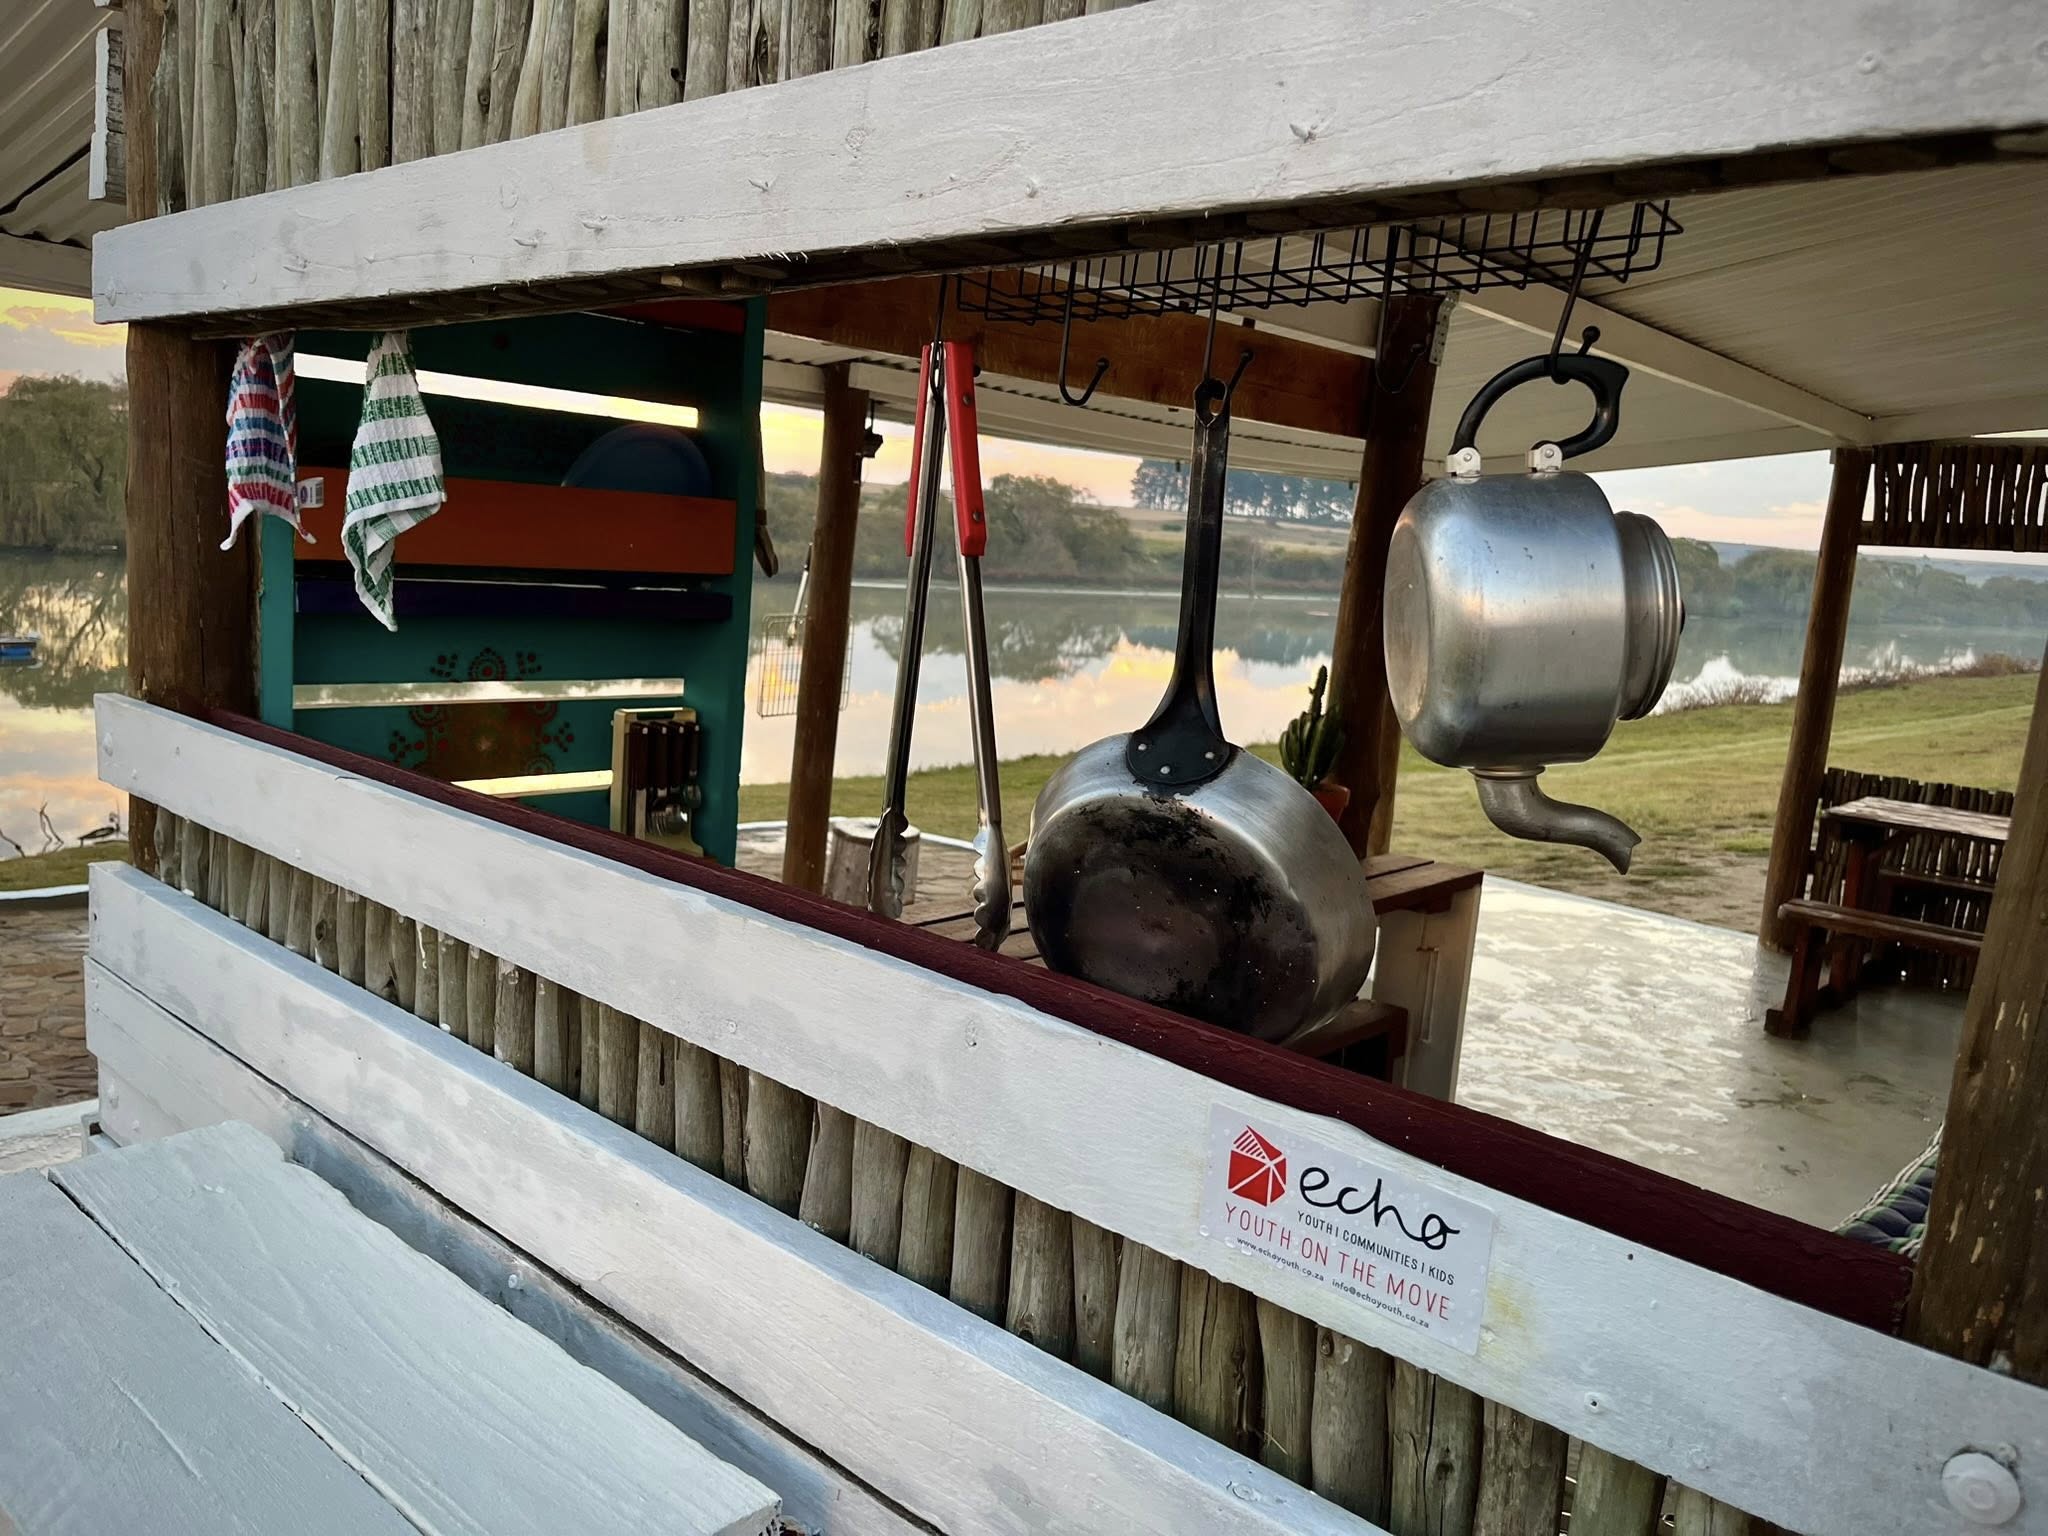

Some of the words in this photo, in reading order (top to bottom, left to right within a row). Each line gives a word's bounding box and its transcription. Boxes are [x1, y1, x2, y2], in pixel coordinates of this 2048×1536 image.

[1297, 1210, 1333, 1235] YOUTH
[1342, 1229, 1418, 1270] COMMUNITIES
[1428, 1266, 1455, 1286] KIDS
[1300, 1167, 1460, 1250] echo
[1225, 1202, 1291, 1250] YOUTH
[1301, 1237, 1328, 1266] ON
[1338, 1251, 1377, 1289] THE
[1387, 1273, 1450, 1321] MOVE
[1332, 1279, 1430, 1329] info@echoyouth.co.za
